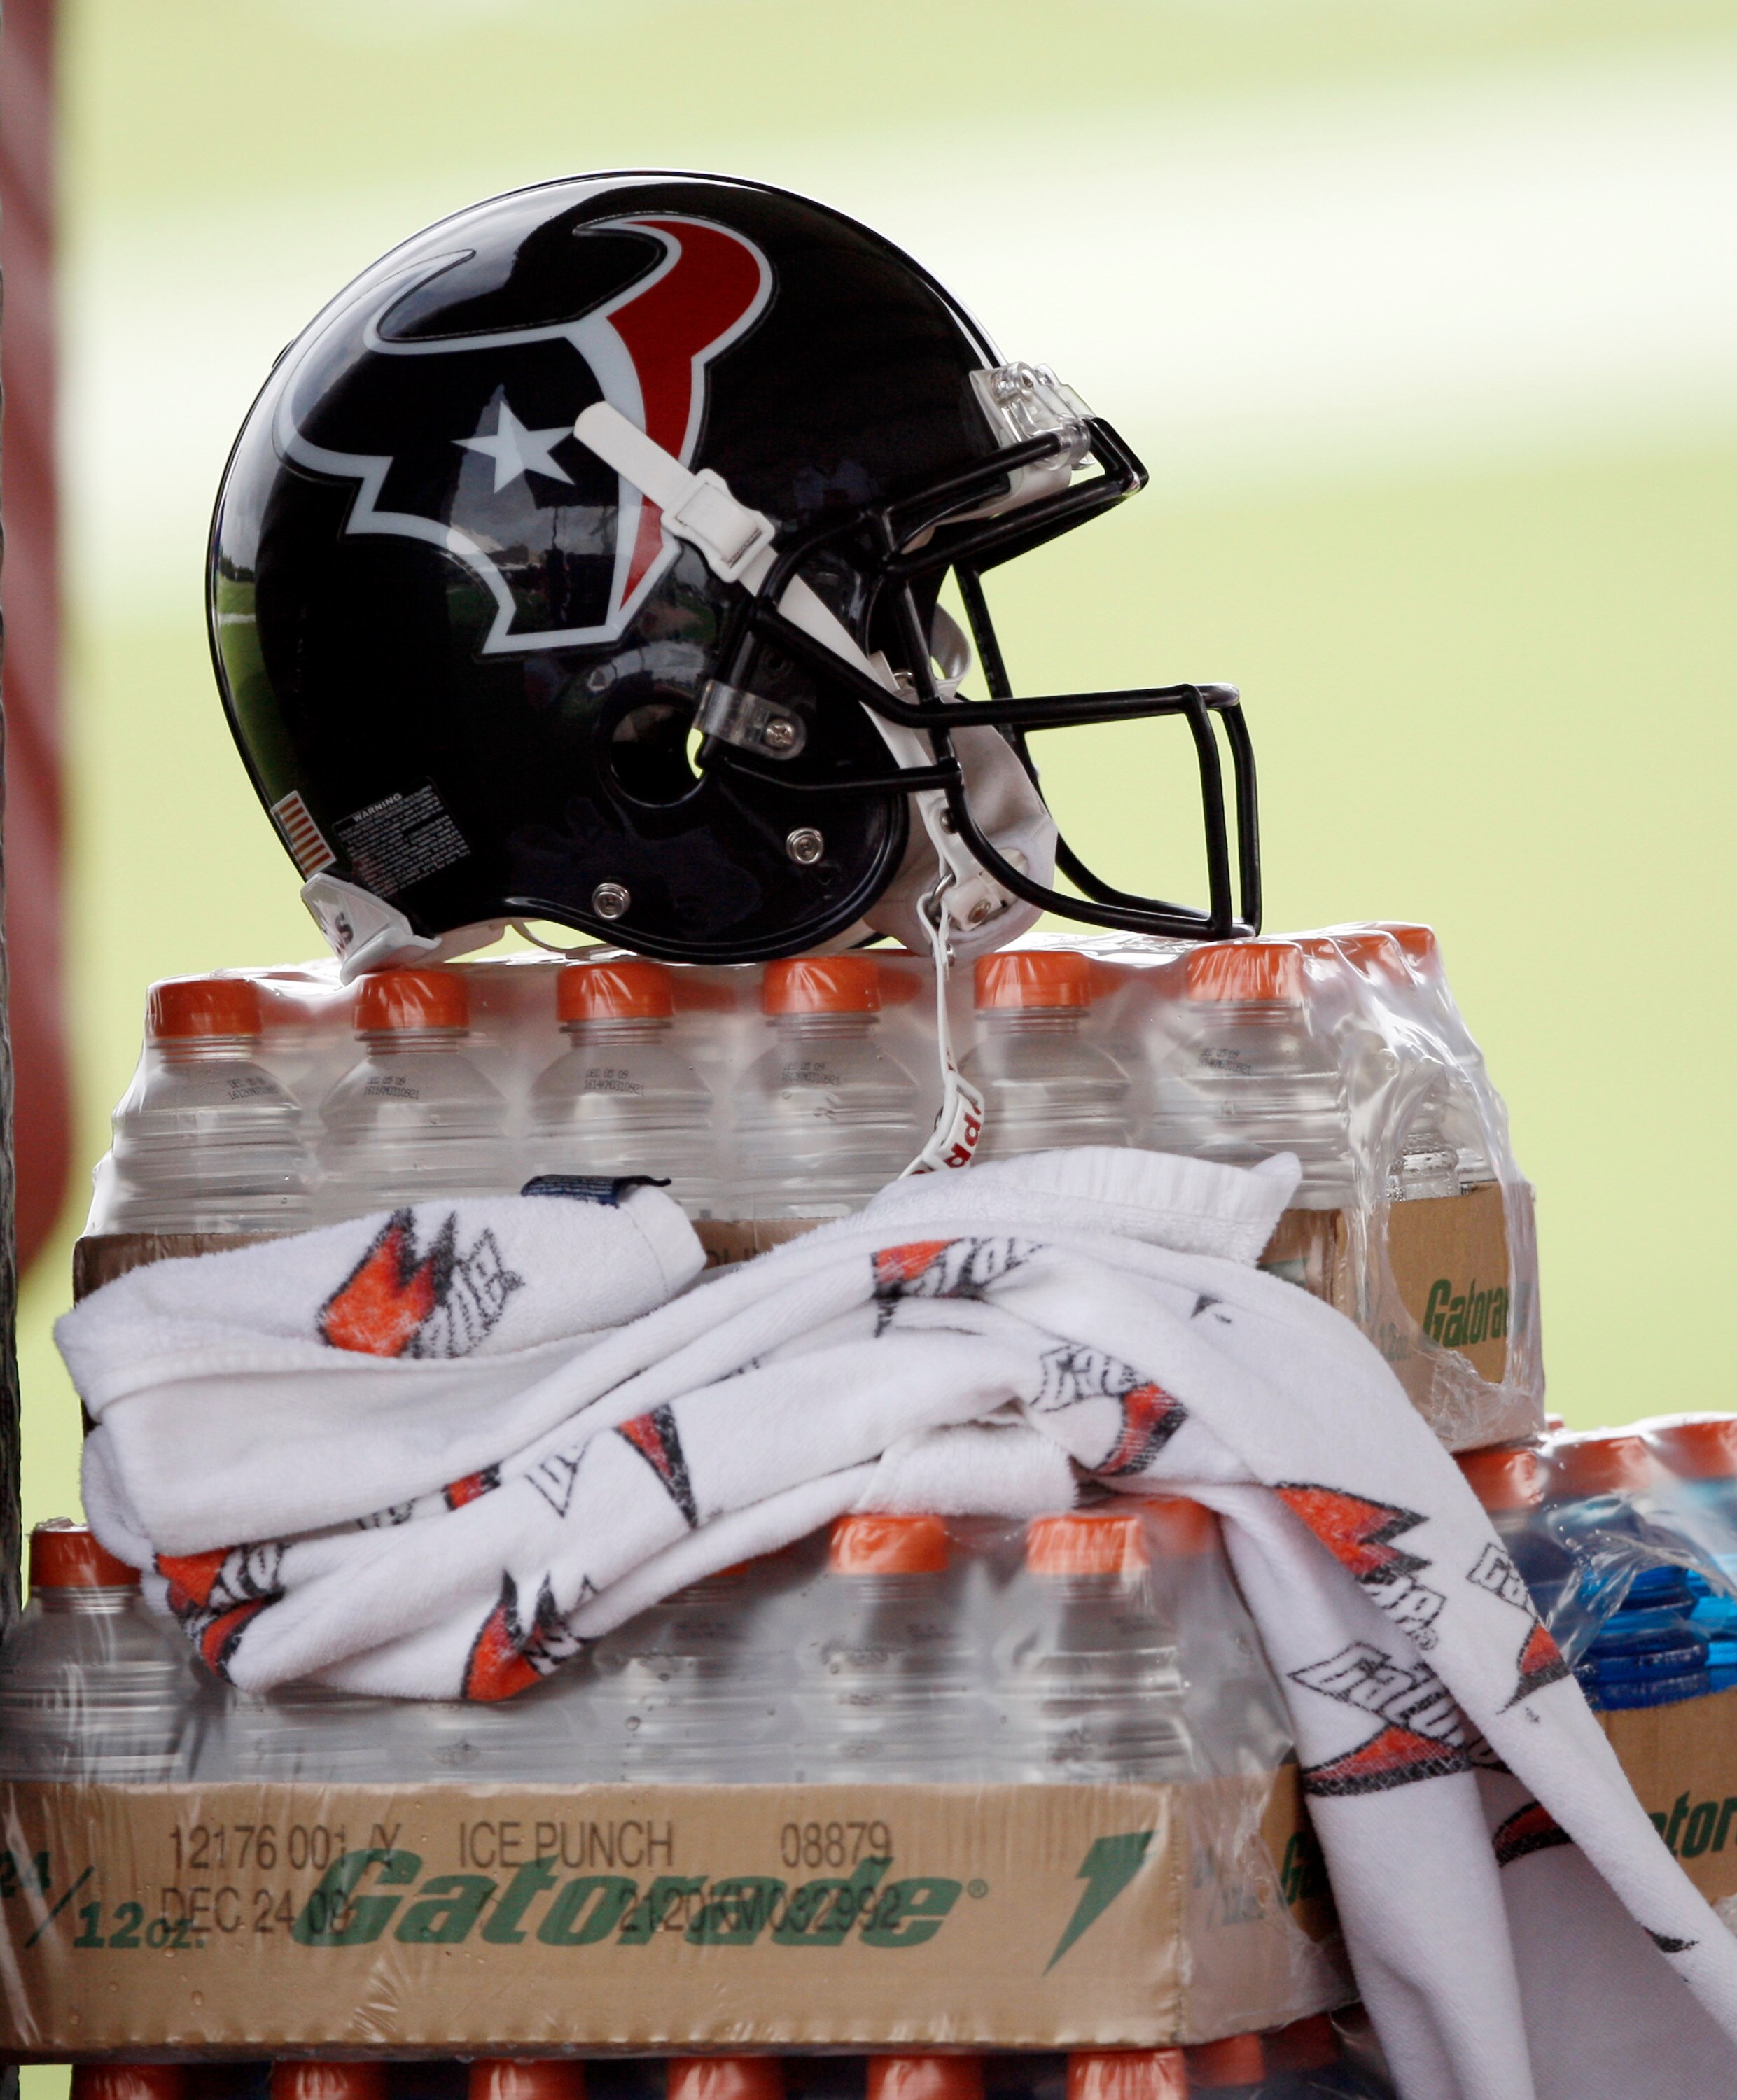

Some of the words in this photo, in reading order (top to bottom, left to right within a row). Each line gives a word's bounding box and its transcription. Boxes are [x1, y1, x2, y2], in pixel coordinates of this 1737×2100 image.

[352, 792, 403, 822] WARNING
[169, 1823, 277, 1870] 12176
[288, 1823, 347, 1870] 001
[459, 1820, 522, 1868] ICE
[534, 1820, 673, 1869] PUNCH
[780, 1821, 893, 1868] 08879
[160, 1886, 242, 1934] DEC
[253, 1888, 294, 1935] 24
